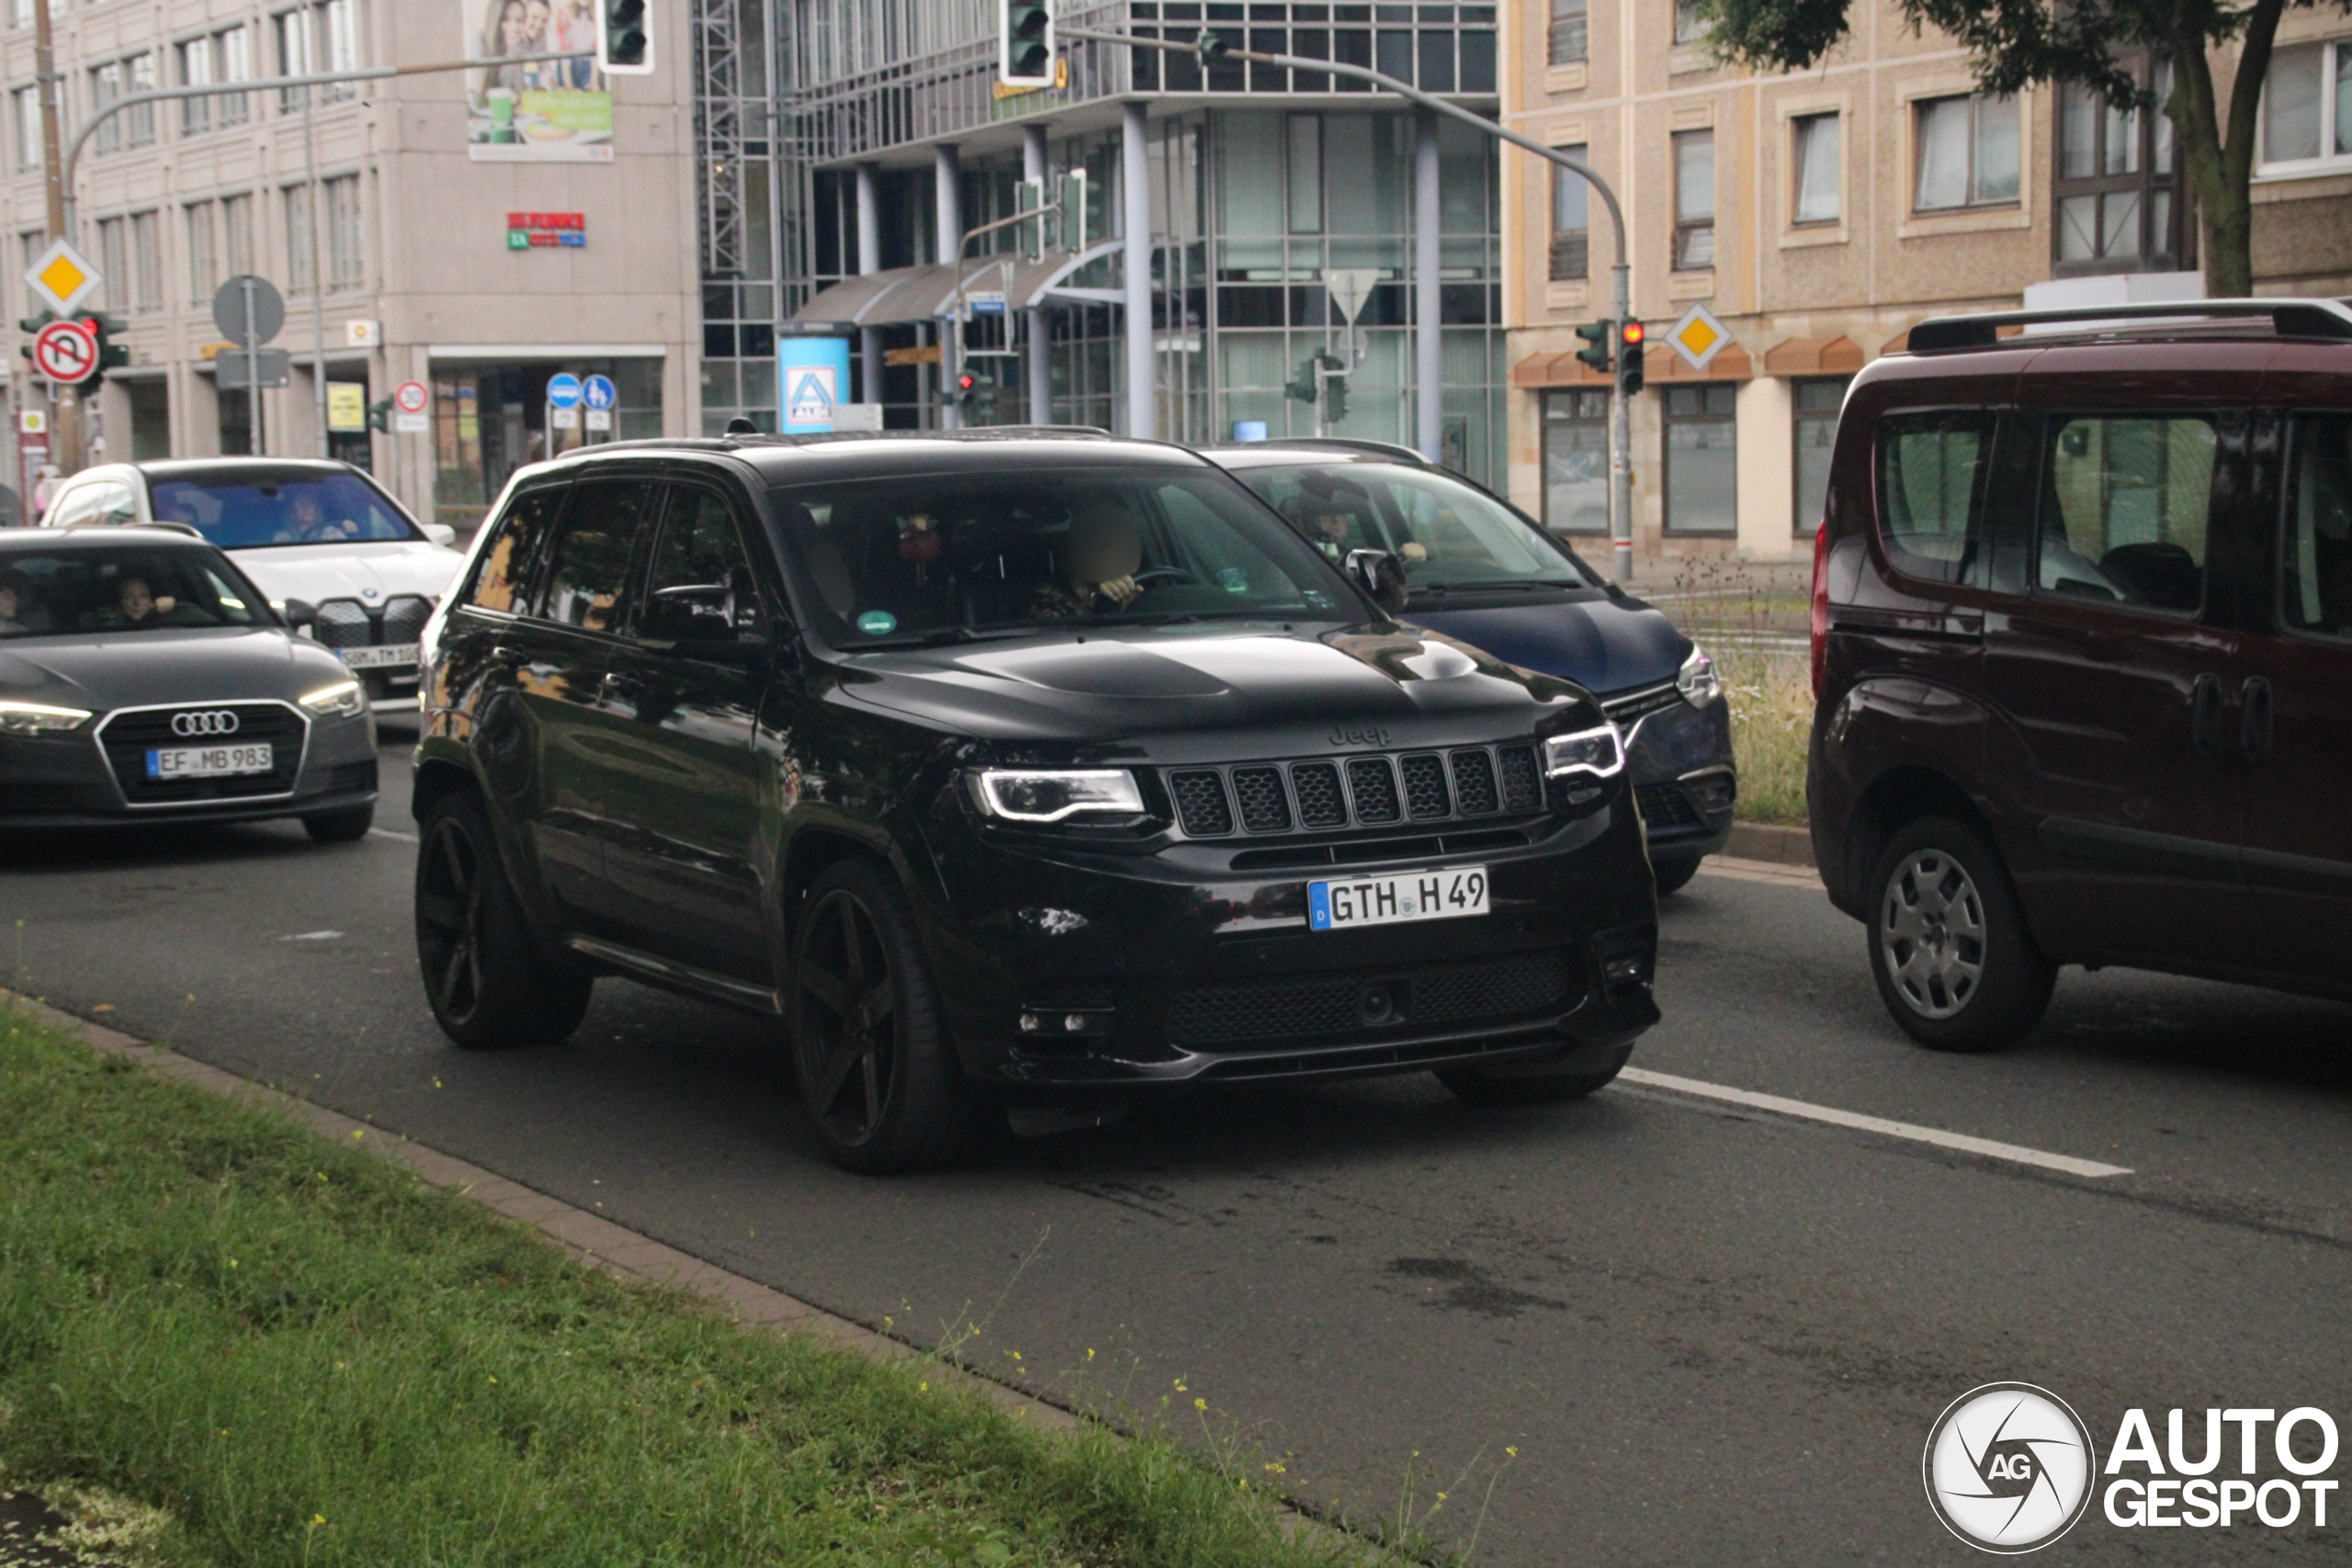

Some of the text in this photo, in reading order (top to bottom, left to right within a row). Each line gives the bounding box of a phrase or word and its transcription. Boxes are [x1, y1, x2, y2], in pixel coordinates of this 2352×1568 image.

[793, 406, 831, 420] ALDI
[1329, 725, 1392, 747] Jeep
[161, 747, 270, 772] EF MB 983
[1331, 873, 1485, 921] GTH H 49
[1317, 910, 1326, 921] D
